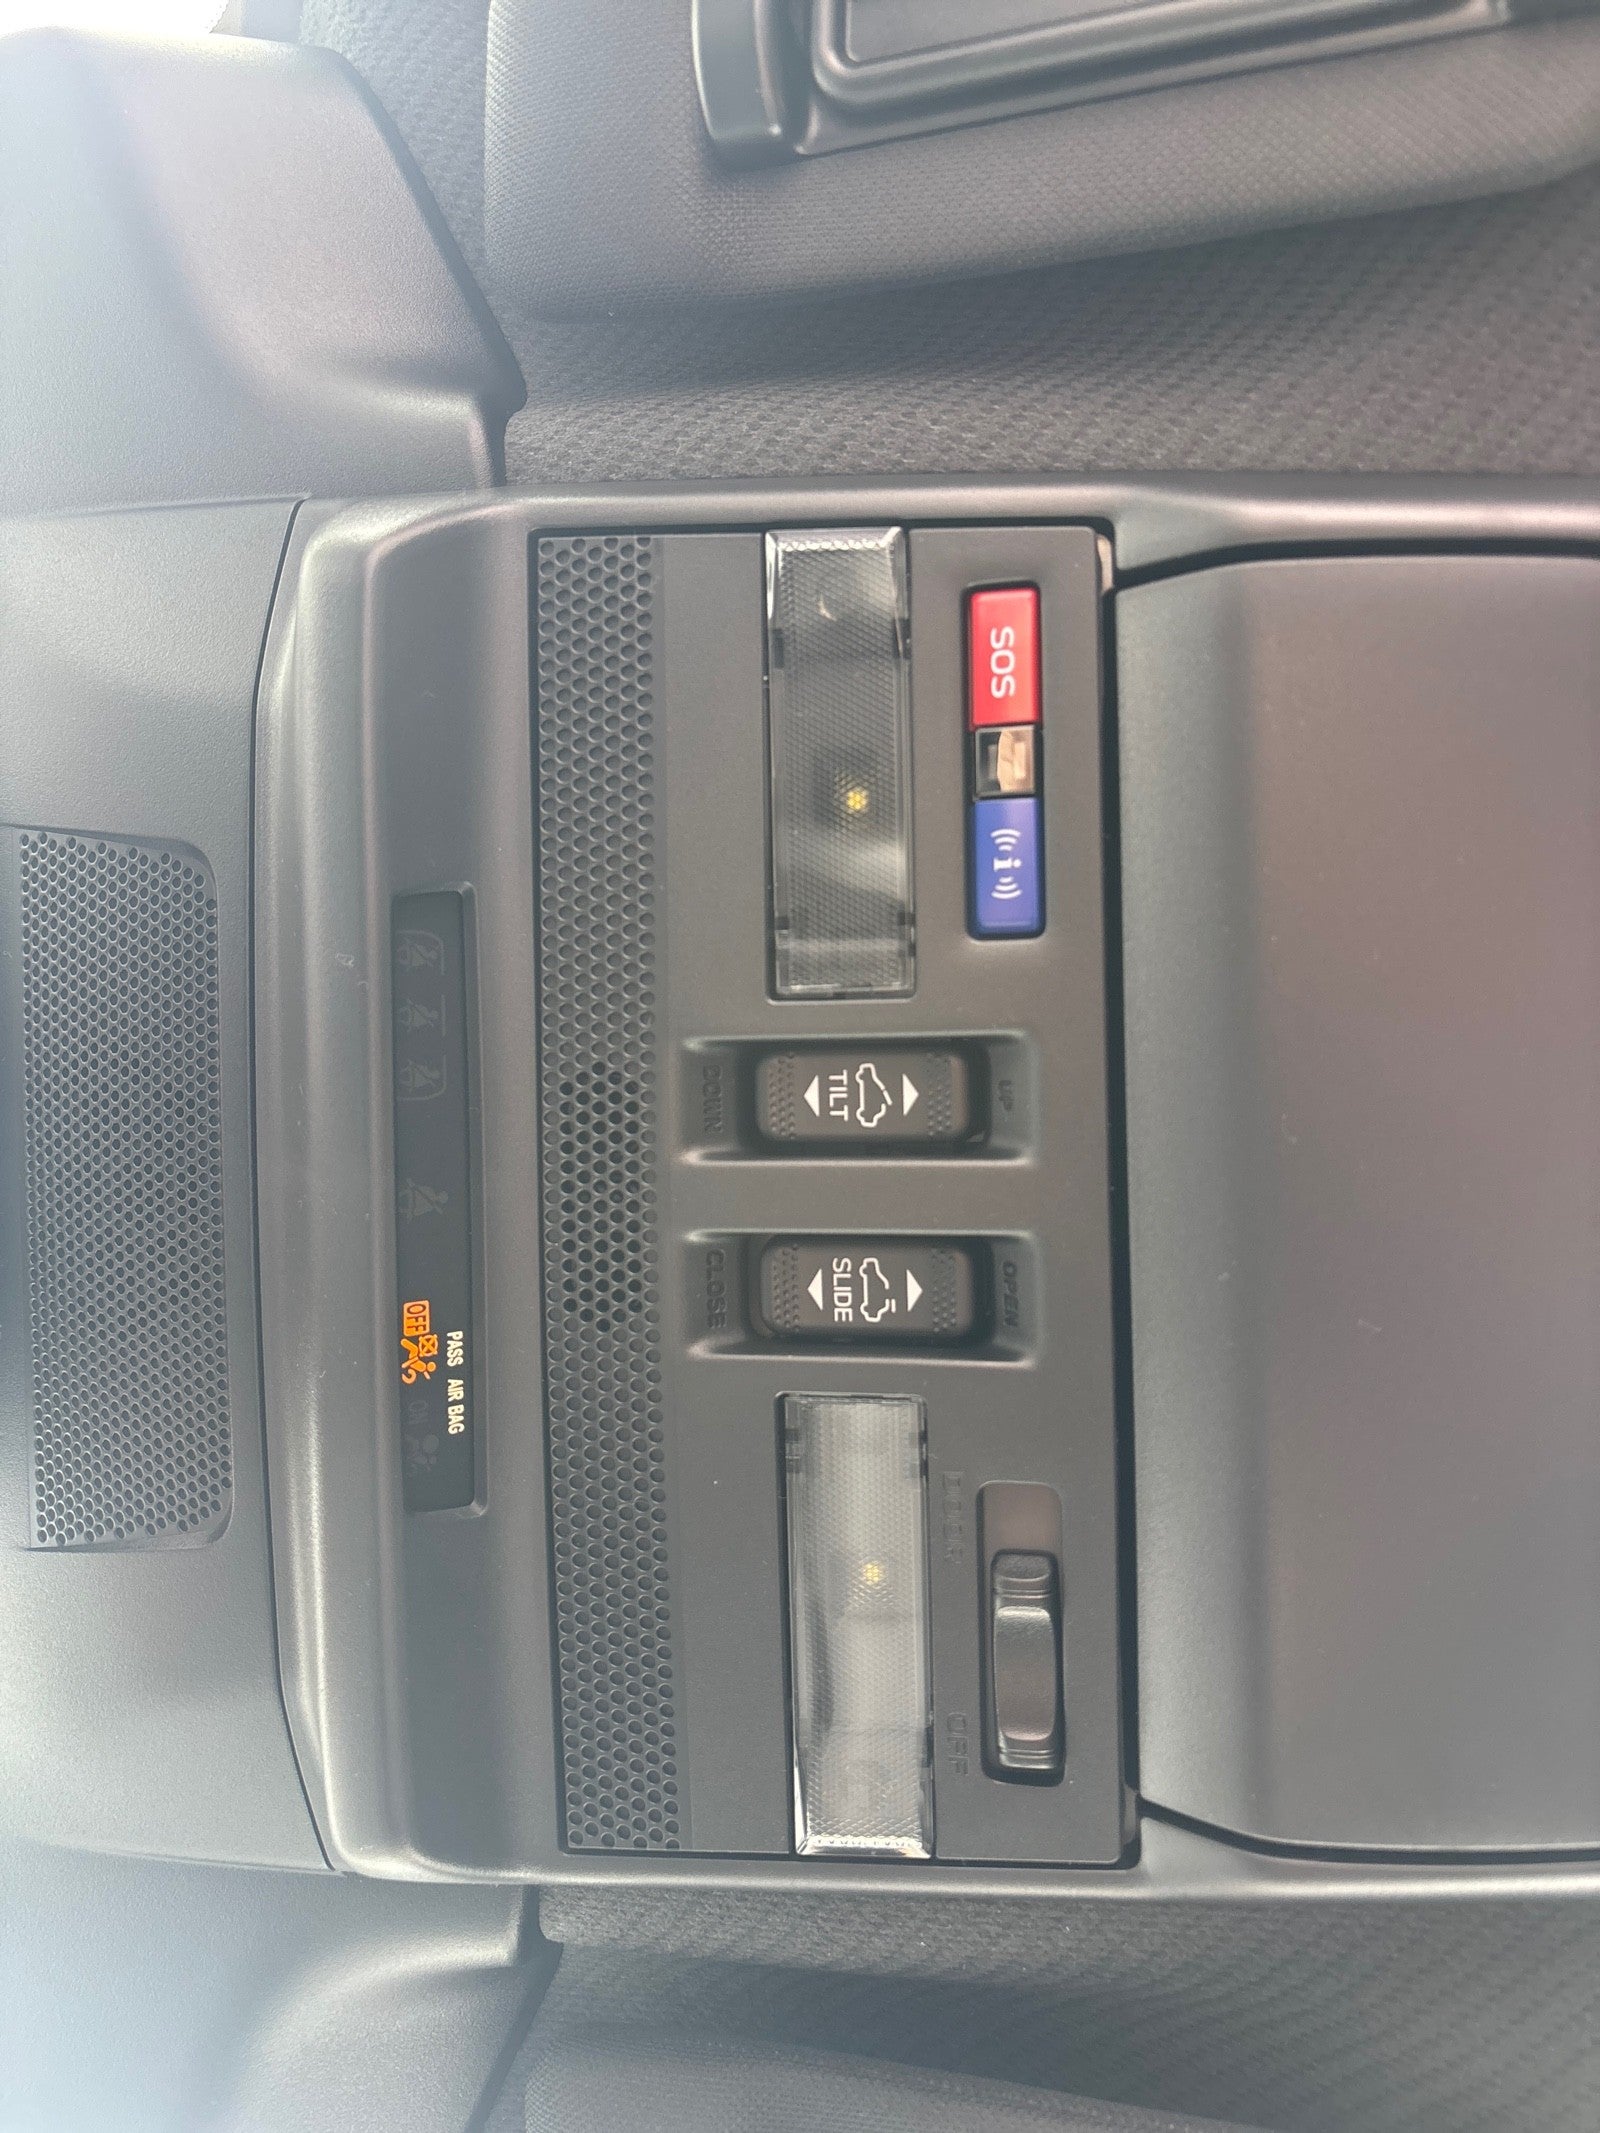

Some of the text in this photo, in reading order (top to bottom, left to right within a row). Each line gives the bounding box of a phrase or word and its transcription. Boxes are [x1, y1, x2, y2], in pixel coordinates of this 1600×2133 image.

[989, 625, 1016, 698] SOS
[703, 1065, 724, 1132] DOWN
[828, 1069, 849, 1122] TILT
[997, 1079, 1013, 1111] UP
[406, 1304, 426, 1332] OFF
[706, 1249, 727, 1328] CLOSE
[832, 1257, 852, 1323] SLIDE
[1002, 1260, 1018, 1327] OPEN
[446, 1330, 465, 1434] PASS AIR BAG
[942, 1470, 967, 1564] DOOR
[946, 1712, 969, 1777] OFF
